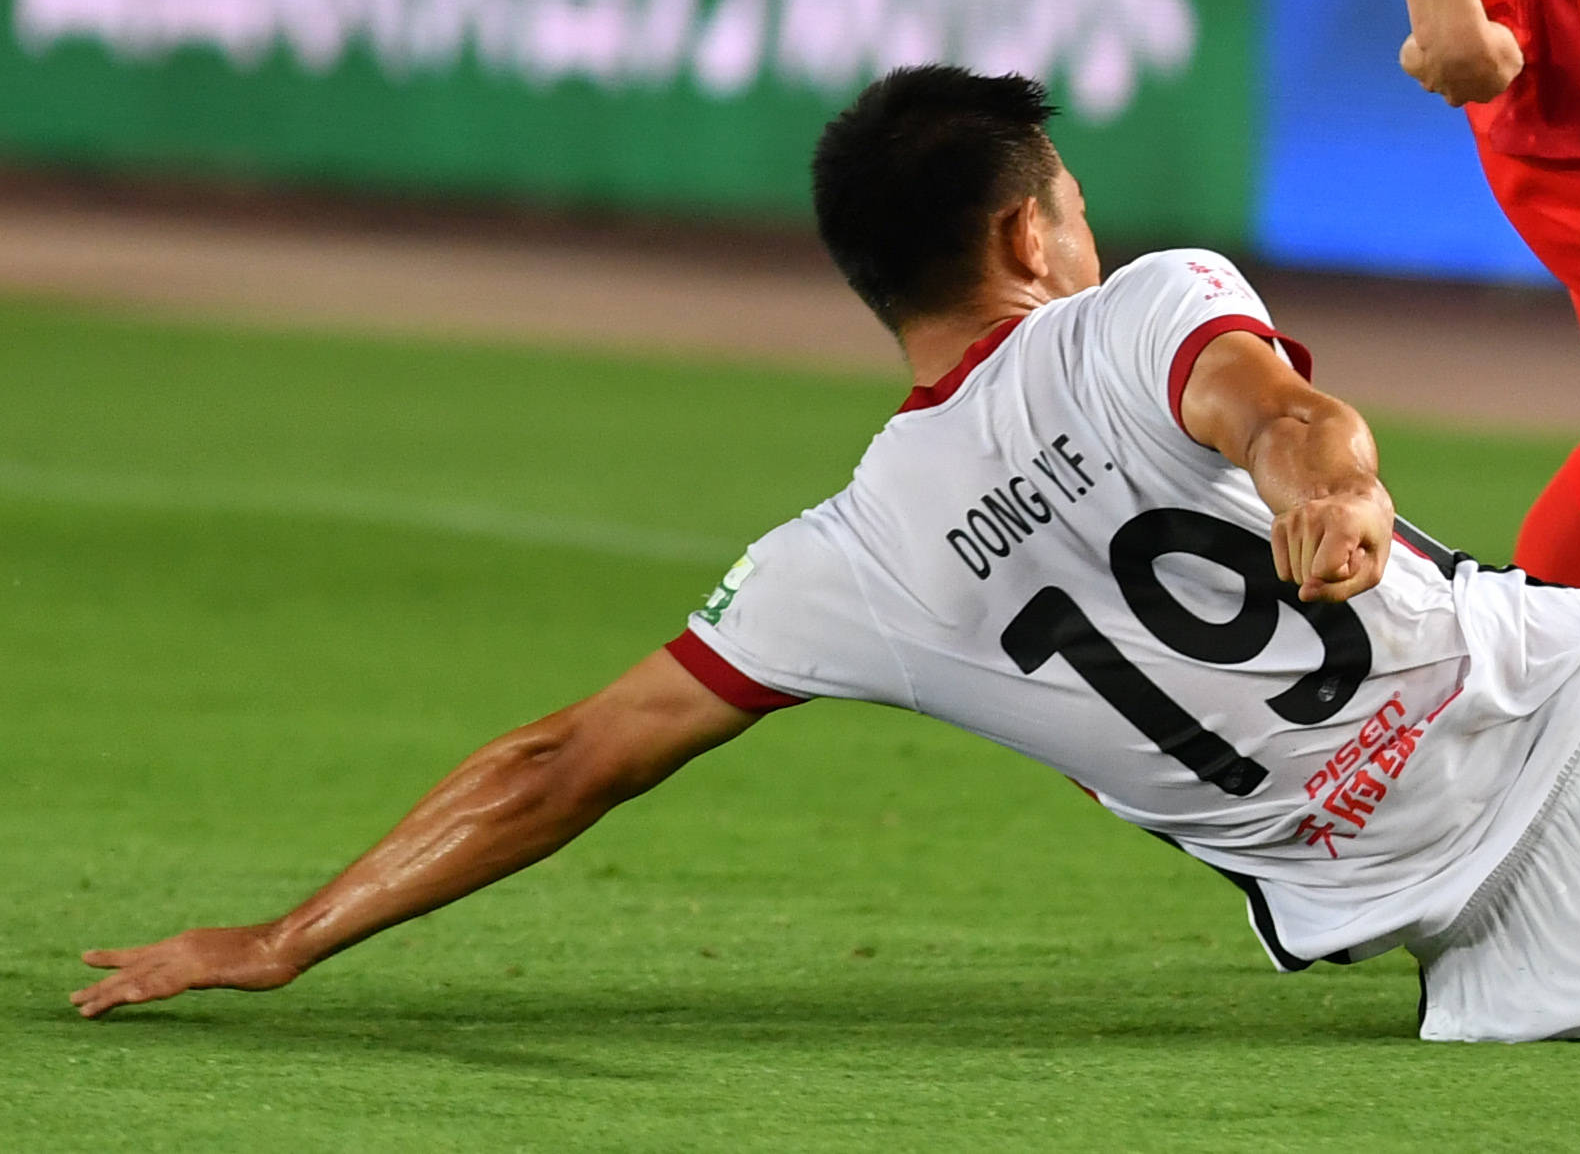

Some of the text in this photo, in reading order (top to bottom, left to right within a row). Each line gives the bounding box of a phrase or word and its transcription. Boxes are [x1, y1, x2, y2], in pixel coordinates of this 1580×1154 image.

[946, 476, 1052, 581] DONG
[1000, 507, 1373, 797] 19
[1304, 698, 1406, 801] PISEN
